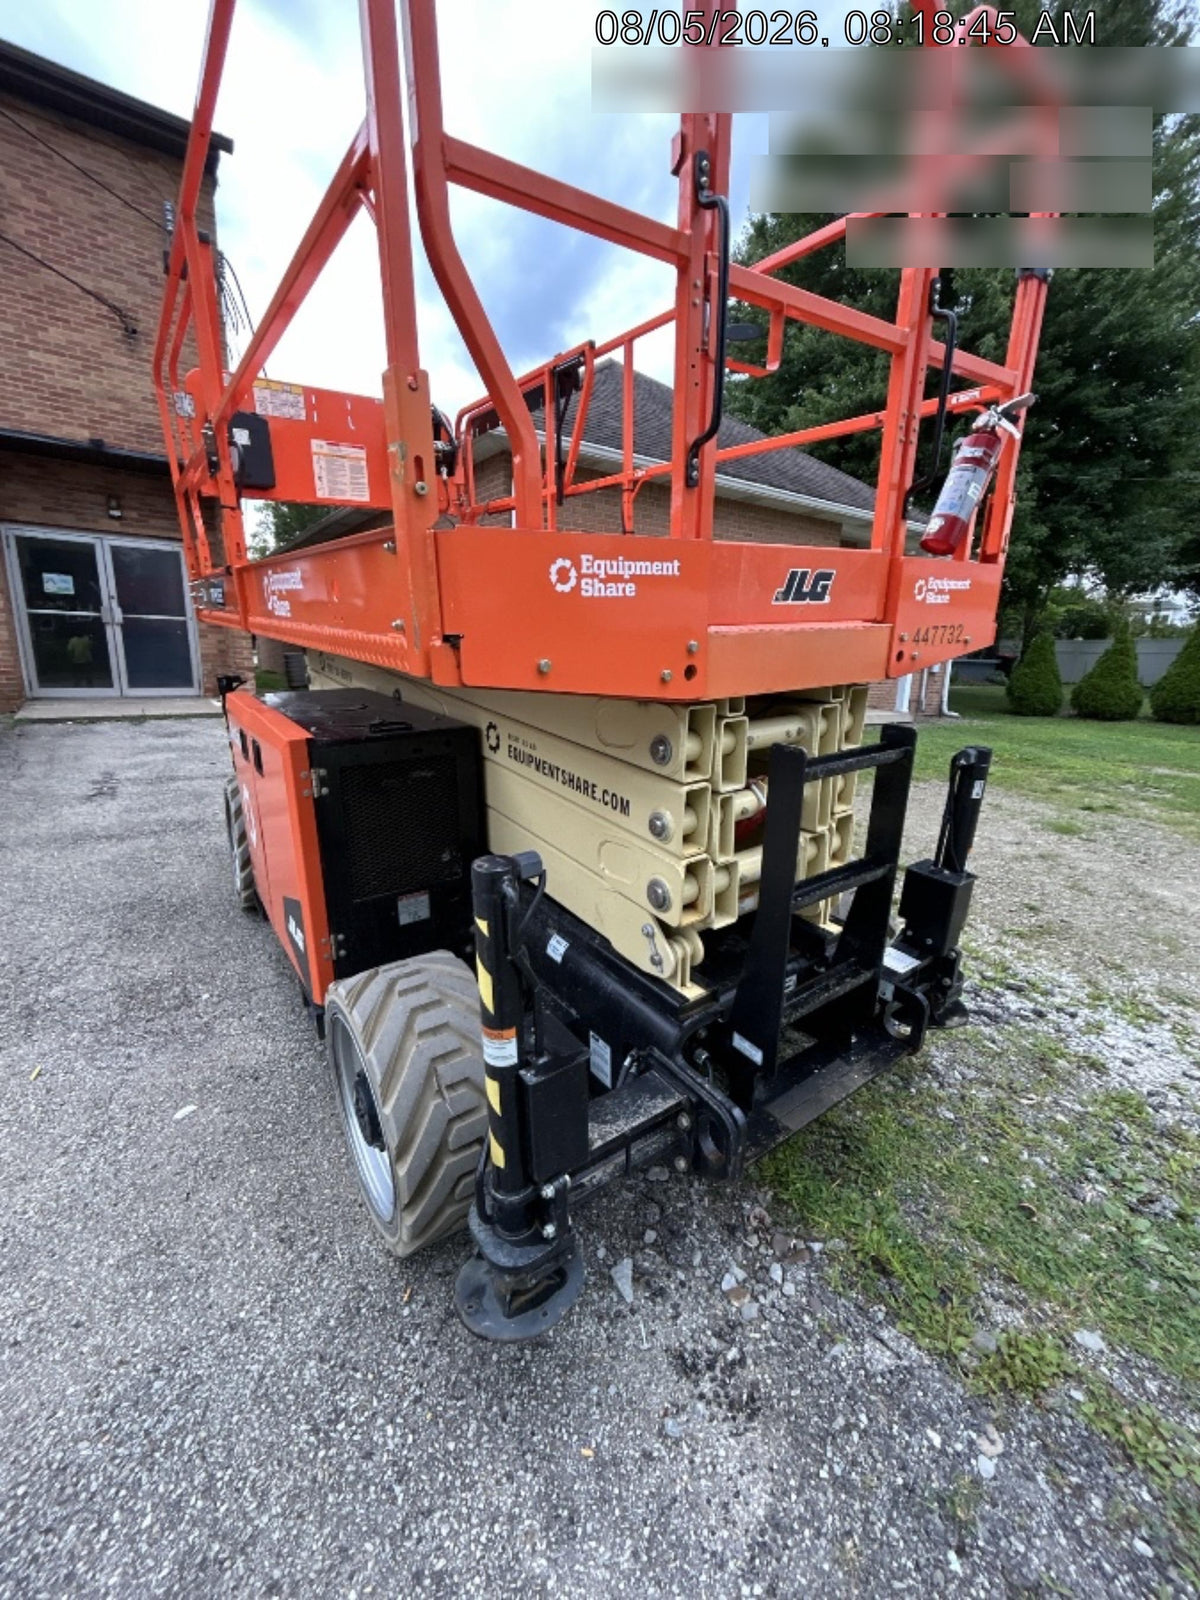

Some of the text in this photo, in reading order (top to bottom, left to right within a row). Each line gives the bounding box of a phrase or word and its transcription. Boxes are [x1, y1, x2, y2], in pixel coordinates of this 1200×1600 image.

[580, 554, 681, 579] Equipment
[580, 577, 636, 597] Share
[771, 568, 836, 605] JLG
[927, 577, 971, 592] Equipment
[912, 623, 964, 646] 447732
[507, 744, 631, 817] EQUIPMENTSHARE.COM
